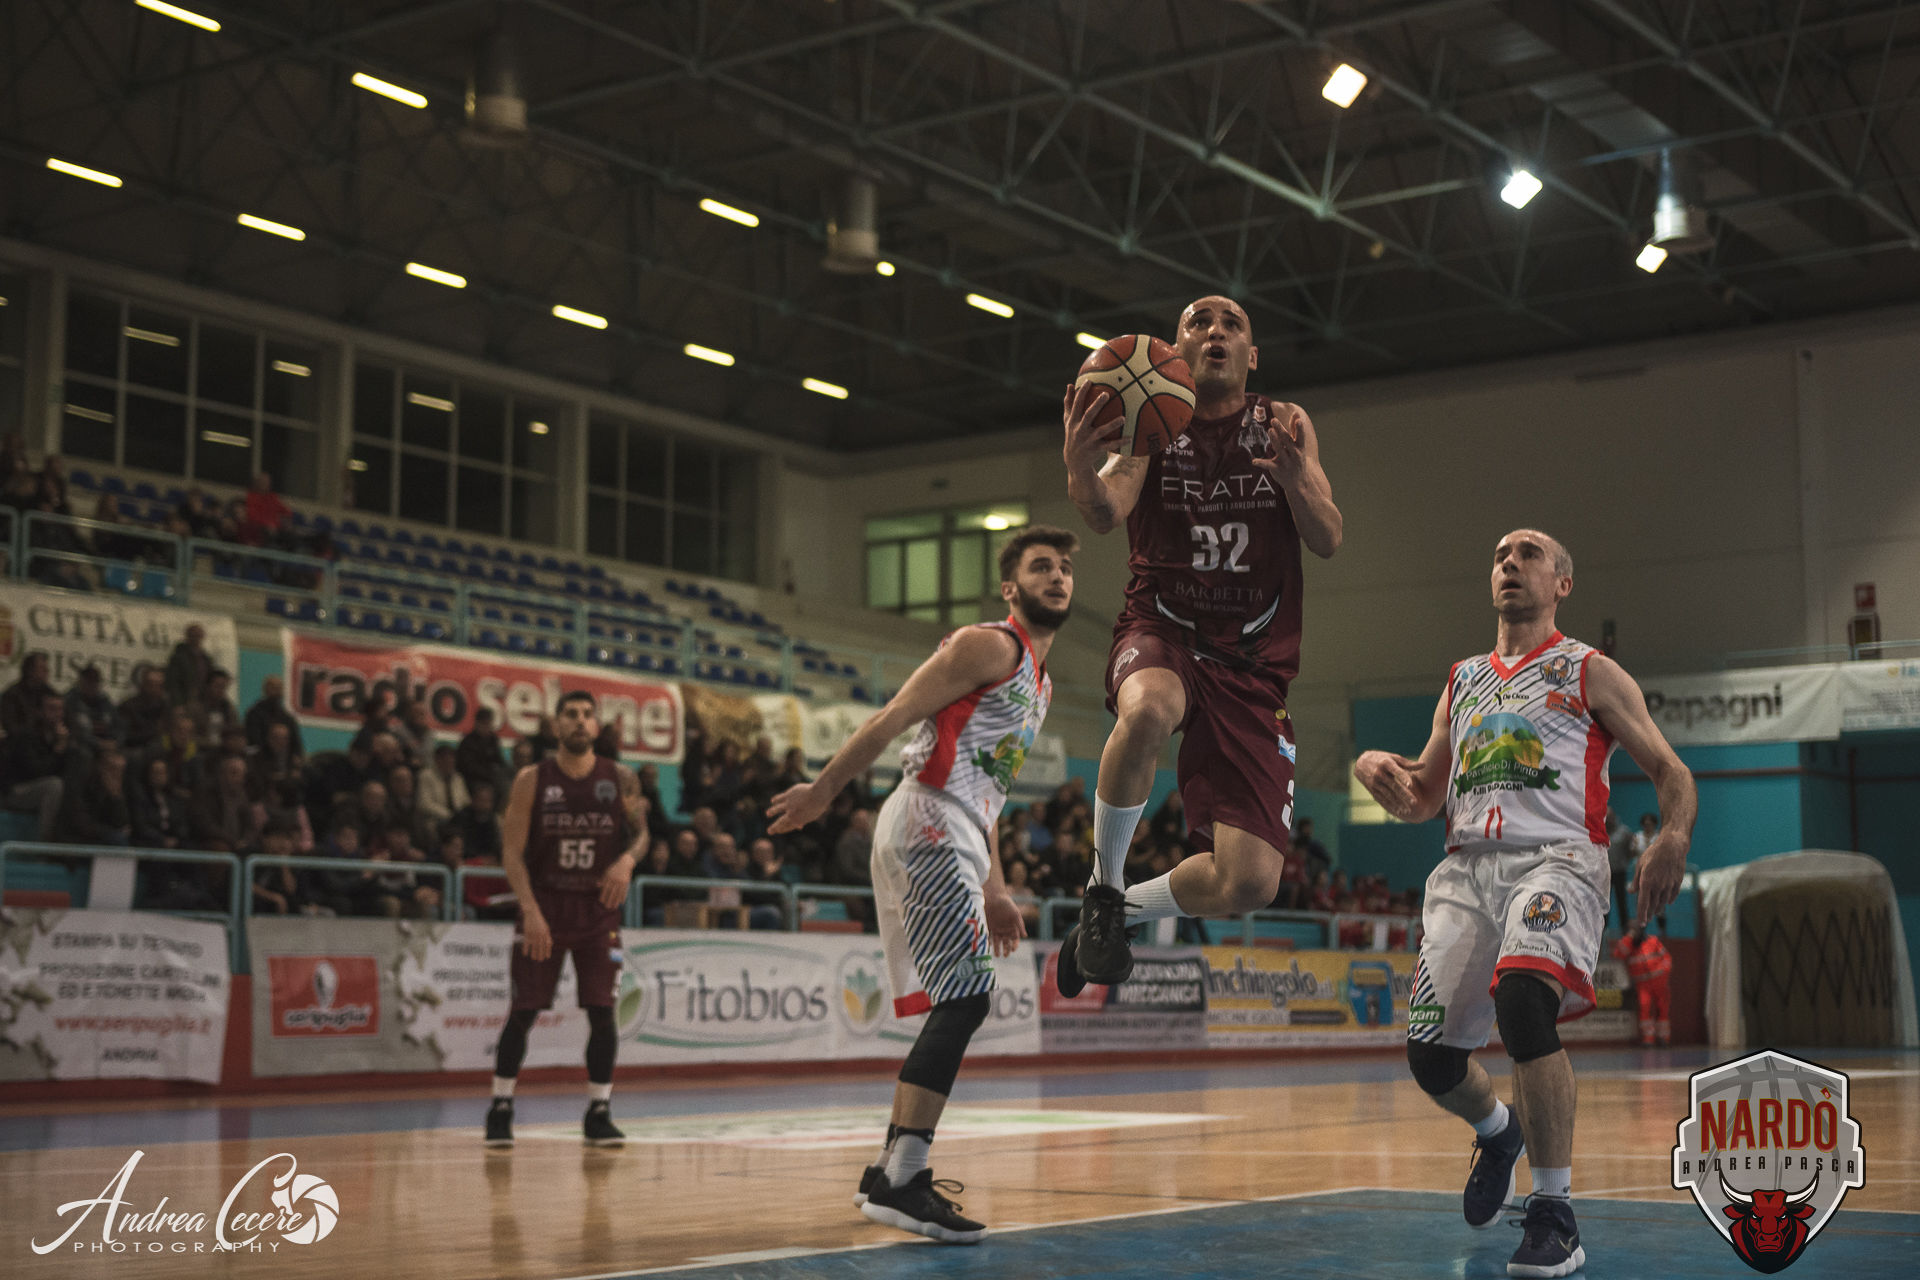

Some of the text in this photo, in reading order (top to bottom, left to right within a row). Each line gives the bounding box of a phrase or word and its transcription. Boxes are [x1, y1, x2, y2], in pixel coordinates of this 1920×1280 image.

[1161, 473, 1276, 501] FRATA
[1190, 522, 1251, 572] 32
[1175, 581, 1264, 602] BARBETTA
[28, 604, 171, 649] CITTÀ di
[476, 676, 673, 748] selne
[1644, 683, 1783, 729] Papagni
[1501, 759, 1511, 770] Di
[1513, 761, 1539, 778] Pinto
[542, 813, 615, 828] FRATA
[1485, 805, 1503, 840] 11
[559, 838, 596, 869] 55
[655, 967, 829, 1022] Fitobios
